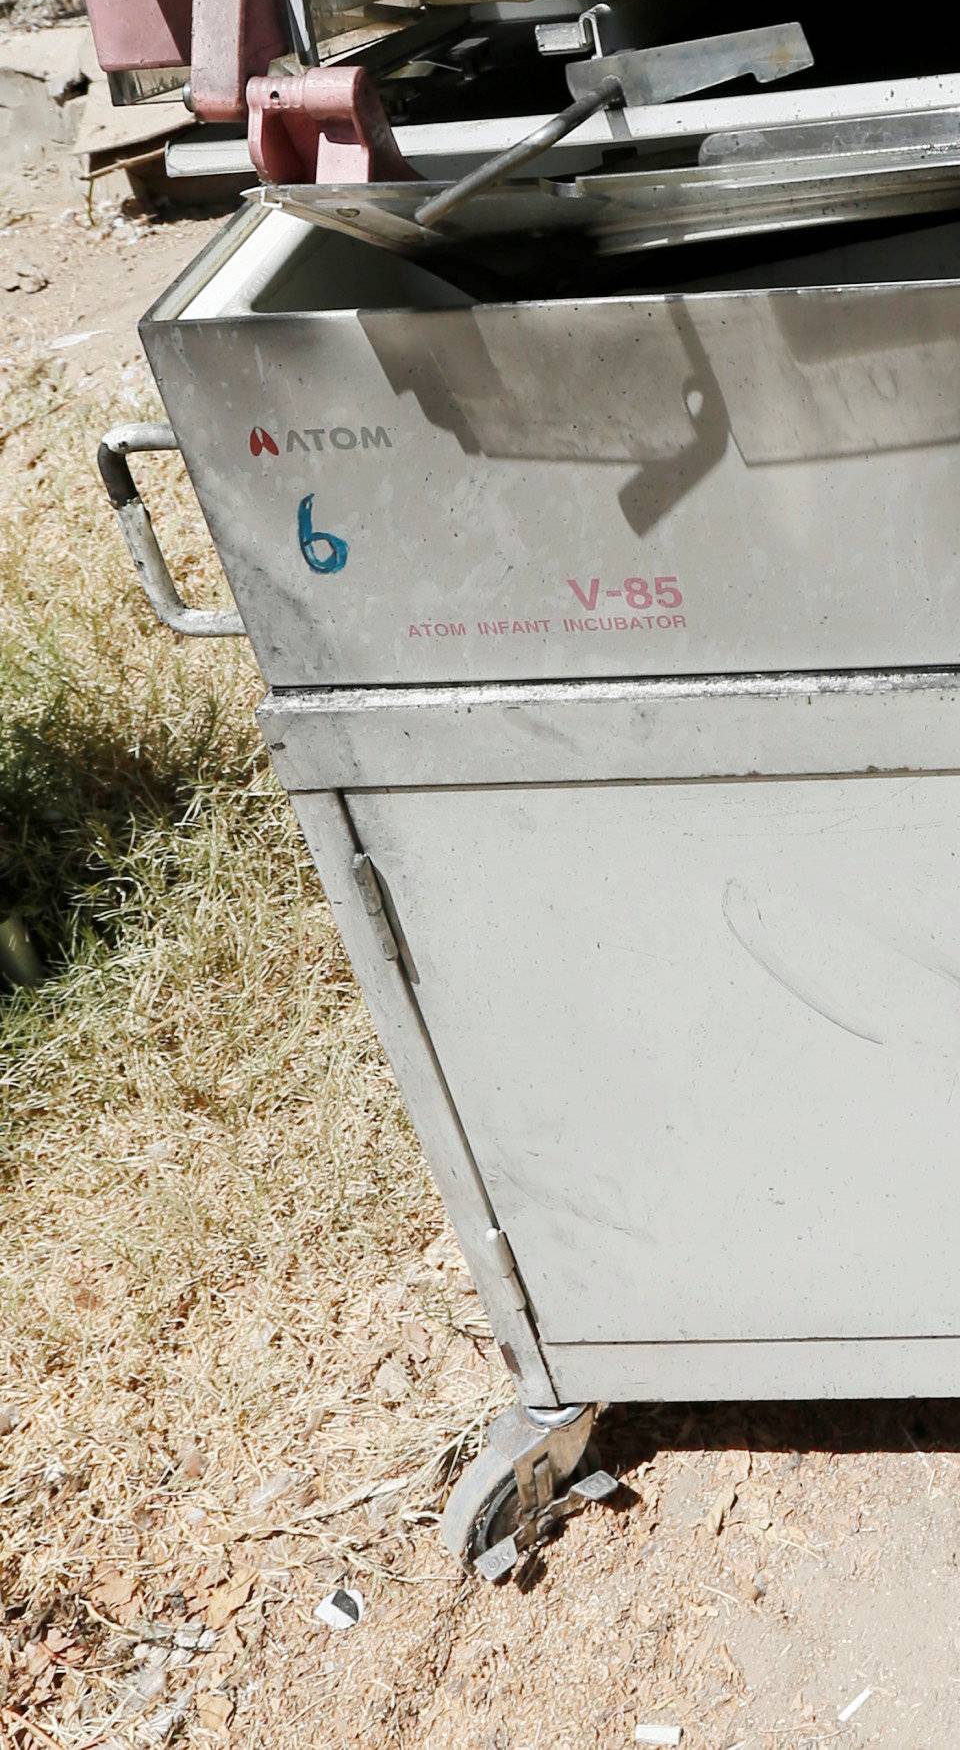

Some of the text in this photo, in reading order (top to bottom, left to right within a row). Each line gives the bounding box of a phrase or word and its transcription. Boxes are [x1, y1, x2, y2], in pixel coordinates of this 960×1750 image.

[286, 425, 393, 452] ATOM
[297, 492, 349, 575] 6
[566, 575, 684, 610] V-85
[408, 614, 688, 638] ATOM INFANT INCUBATOR
